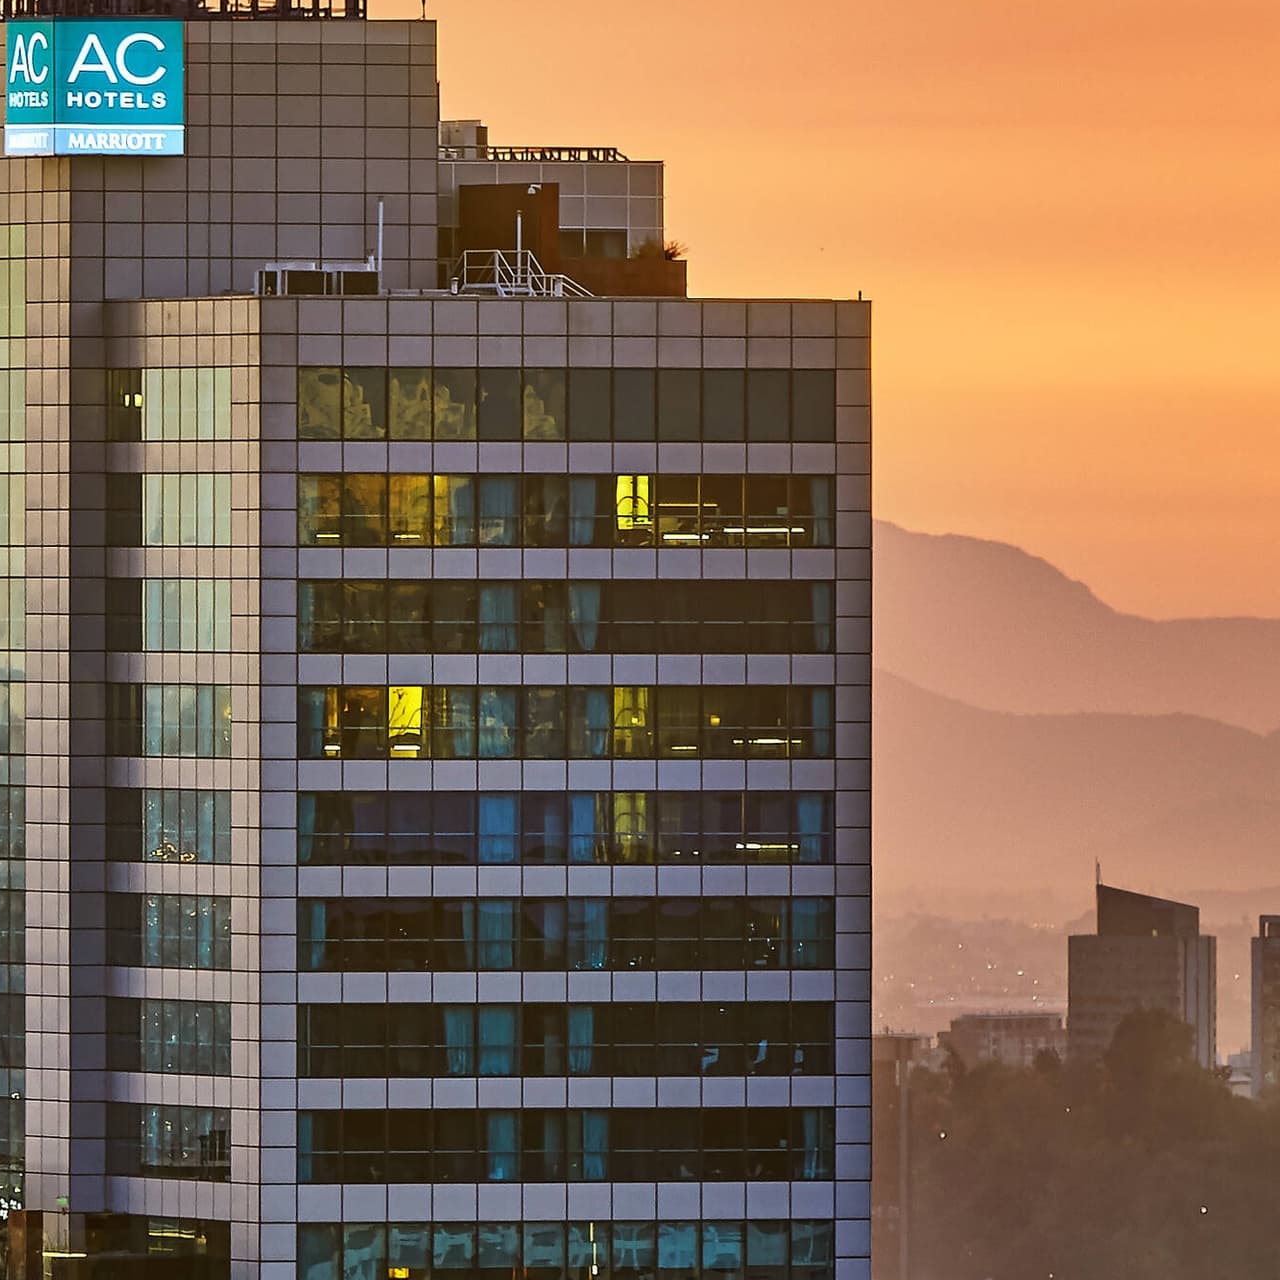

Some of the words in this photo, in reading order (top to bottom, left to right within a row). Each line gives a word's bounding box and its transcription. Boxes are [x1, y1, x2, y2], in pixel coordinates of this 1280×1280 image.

[9, 32, 48, 84] AC
[67, 32, 166, 86] AC
[9, 91, 49, 108] HOTELS
[67, 91, 167, 109] HOTELS
[68, 132, 167, 151] MARRIOTT
